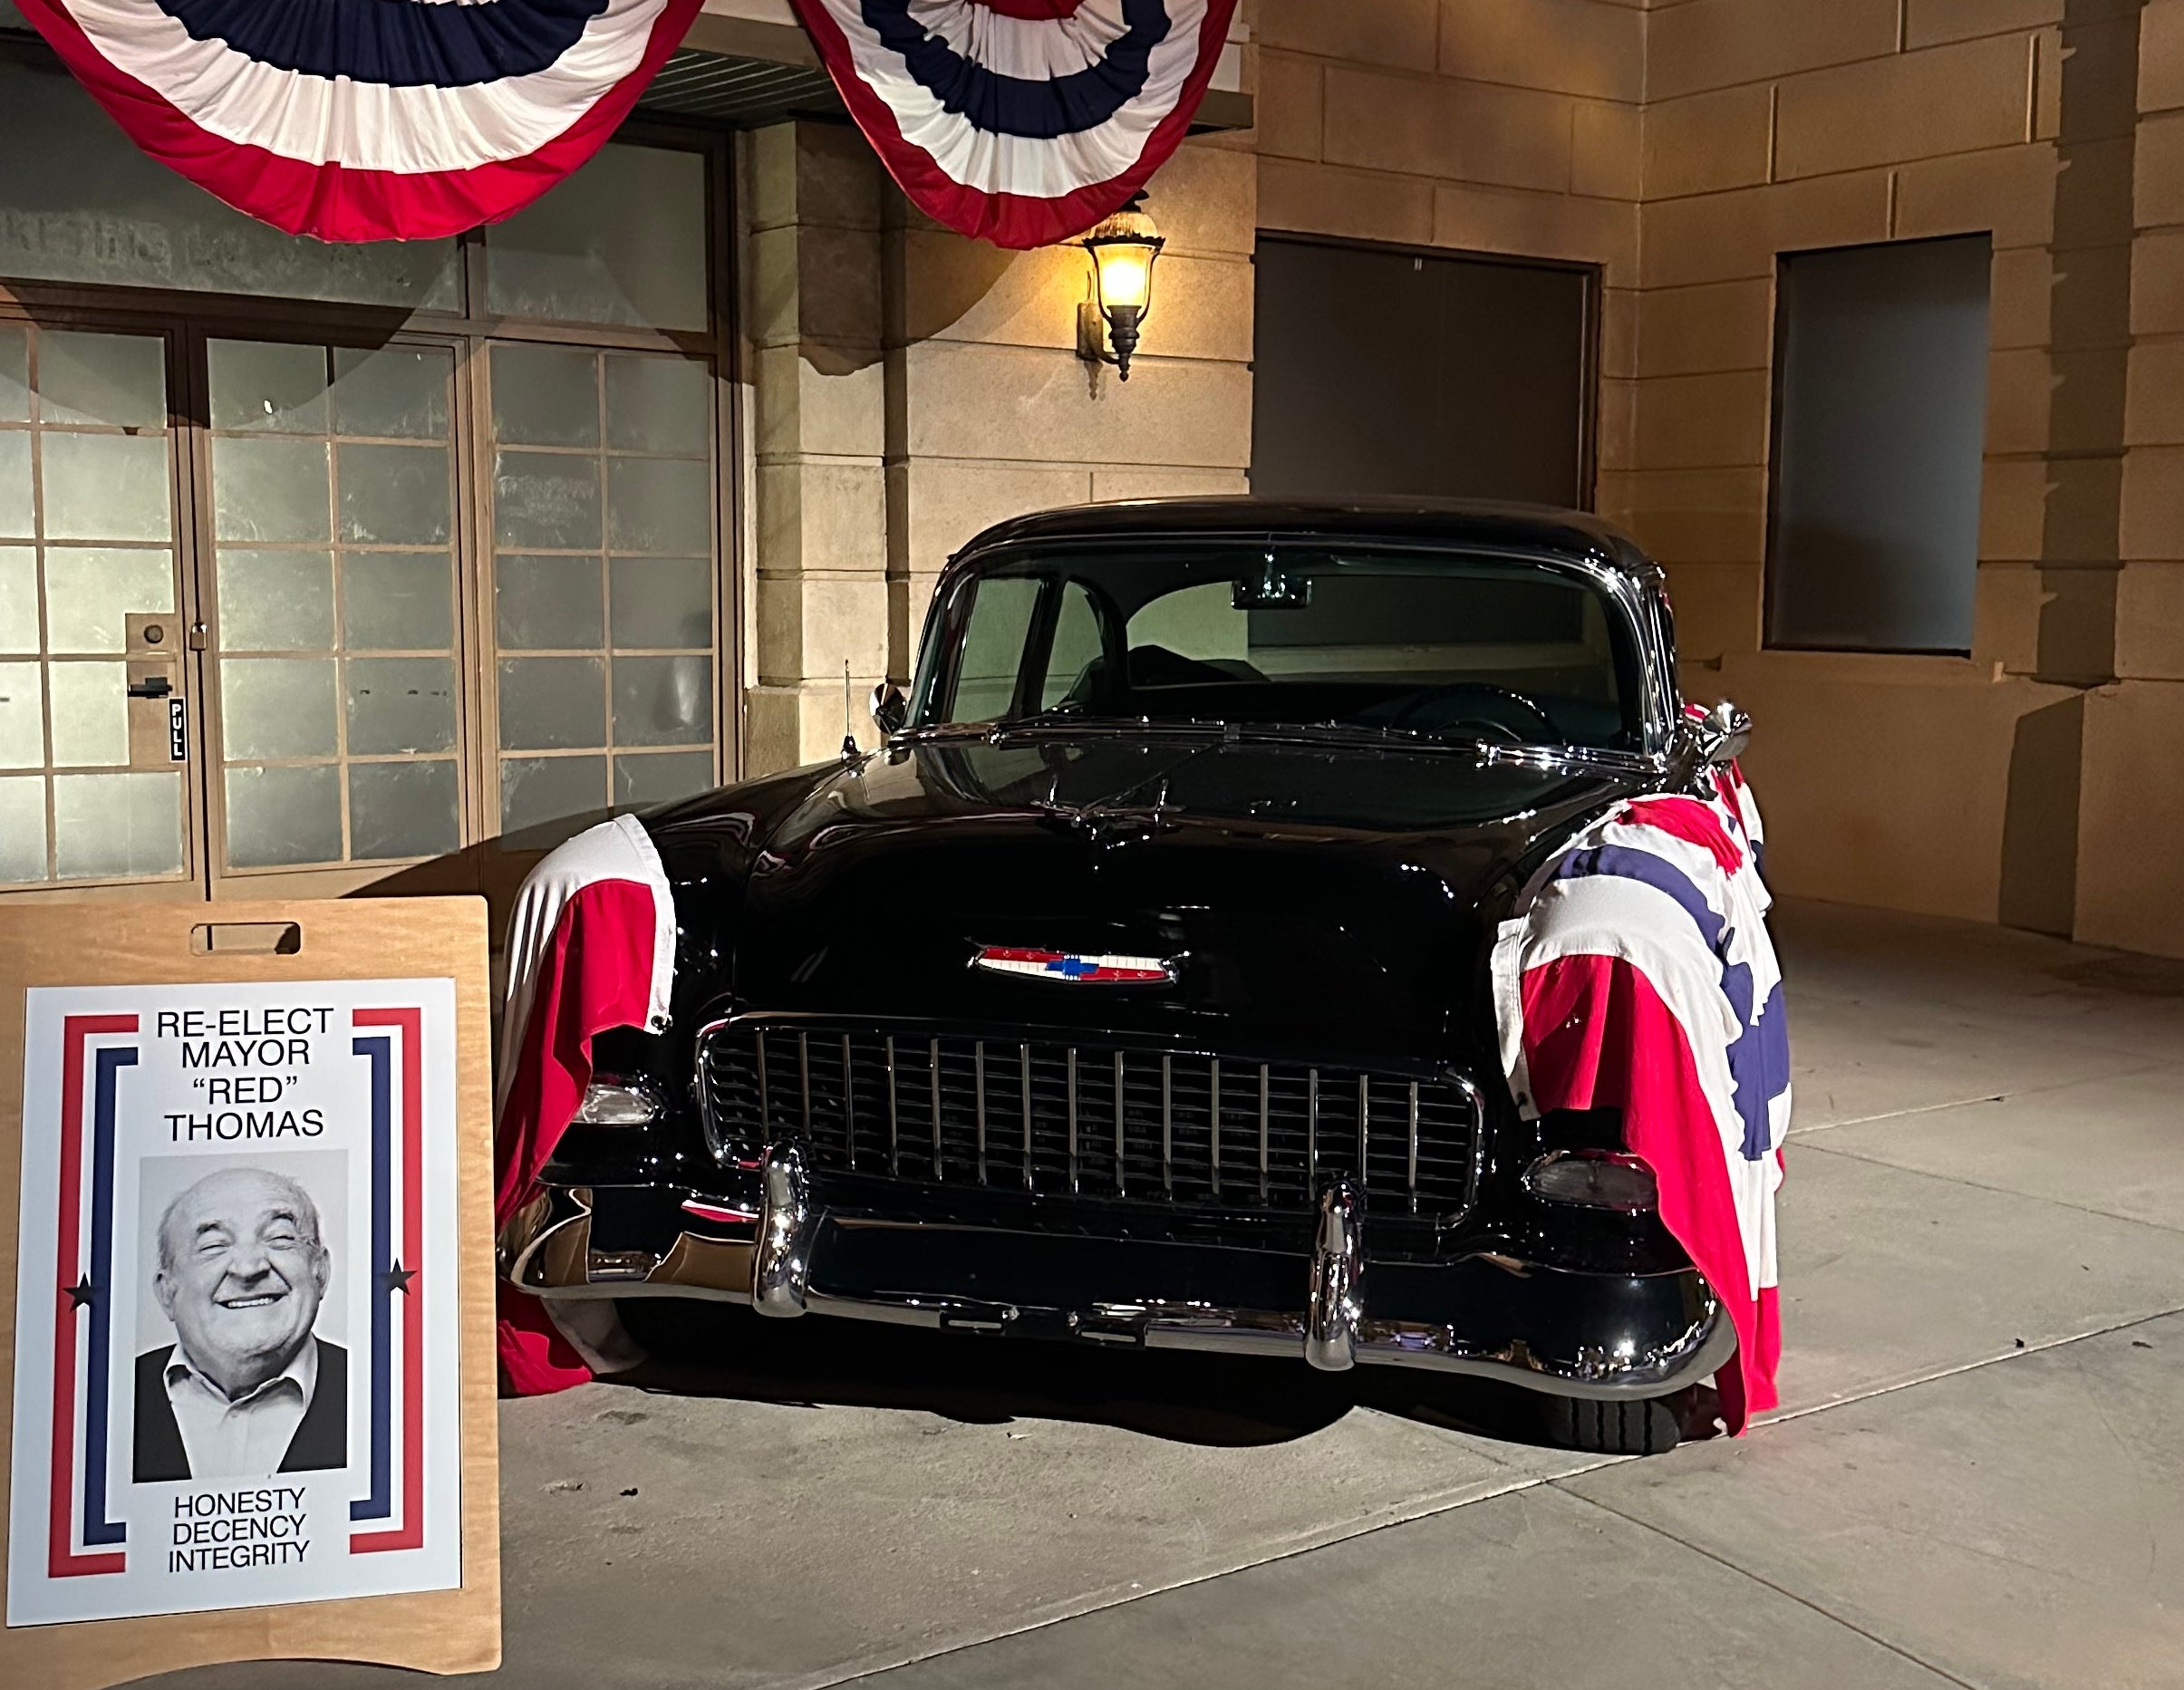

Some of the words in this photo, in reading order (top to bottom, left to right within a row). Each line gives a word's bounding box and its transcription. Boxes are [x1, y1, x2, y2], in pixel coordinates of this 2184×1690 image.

[171, 703, 182, 757] PULL
[158, 1008, 334, 1038] RE-ELECT
[183, 1039, 310, 1067] MAYOR
[194, 1076, 297, 1105] “RED”
[164, 1109, 324, 1141] THOMAS
[175, 1487, 306, 1518] HONESTY
[174, 1514, 306, 1545] DECENCY
[169, 1540, 310, 1573] INTEGRITY
